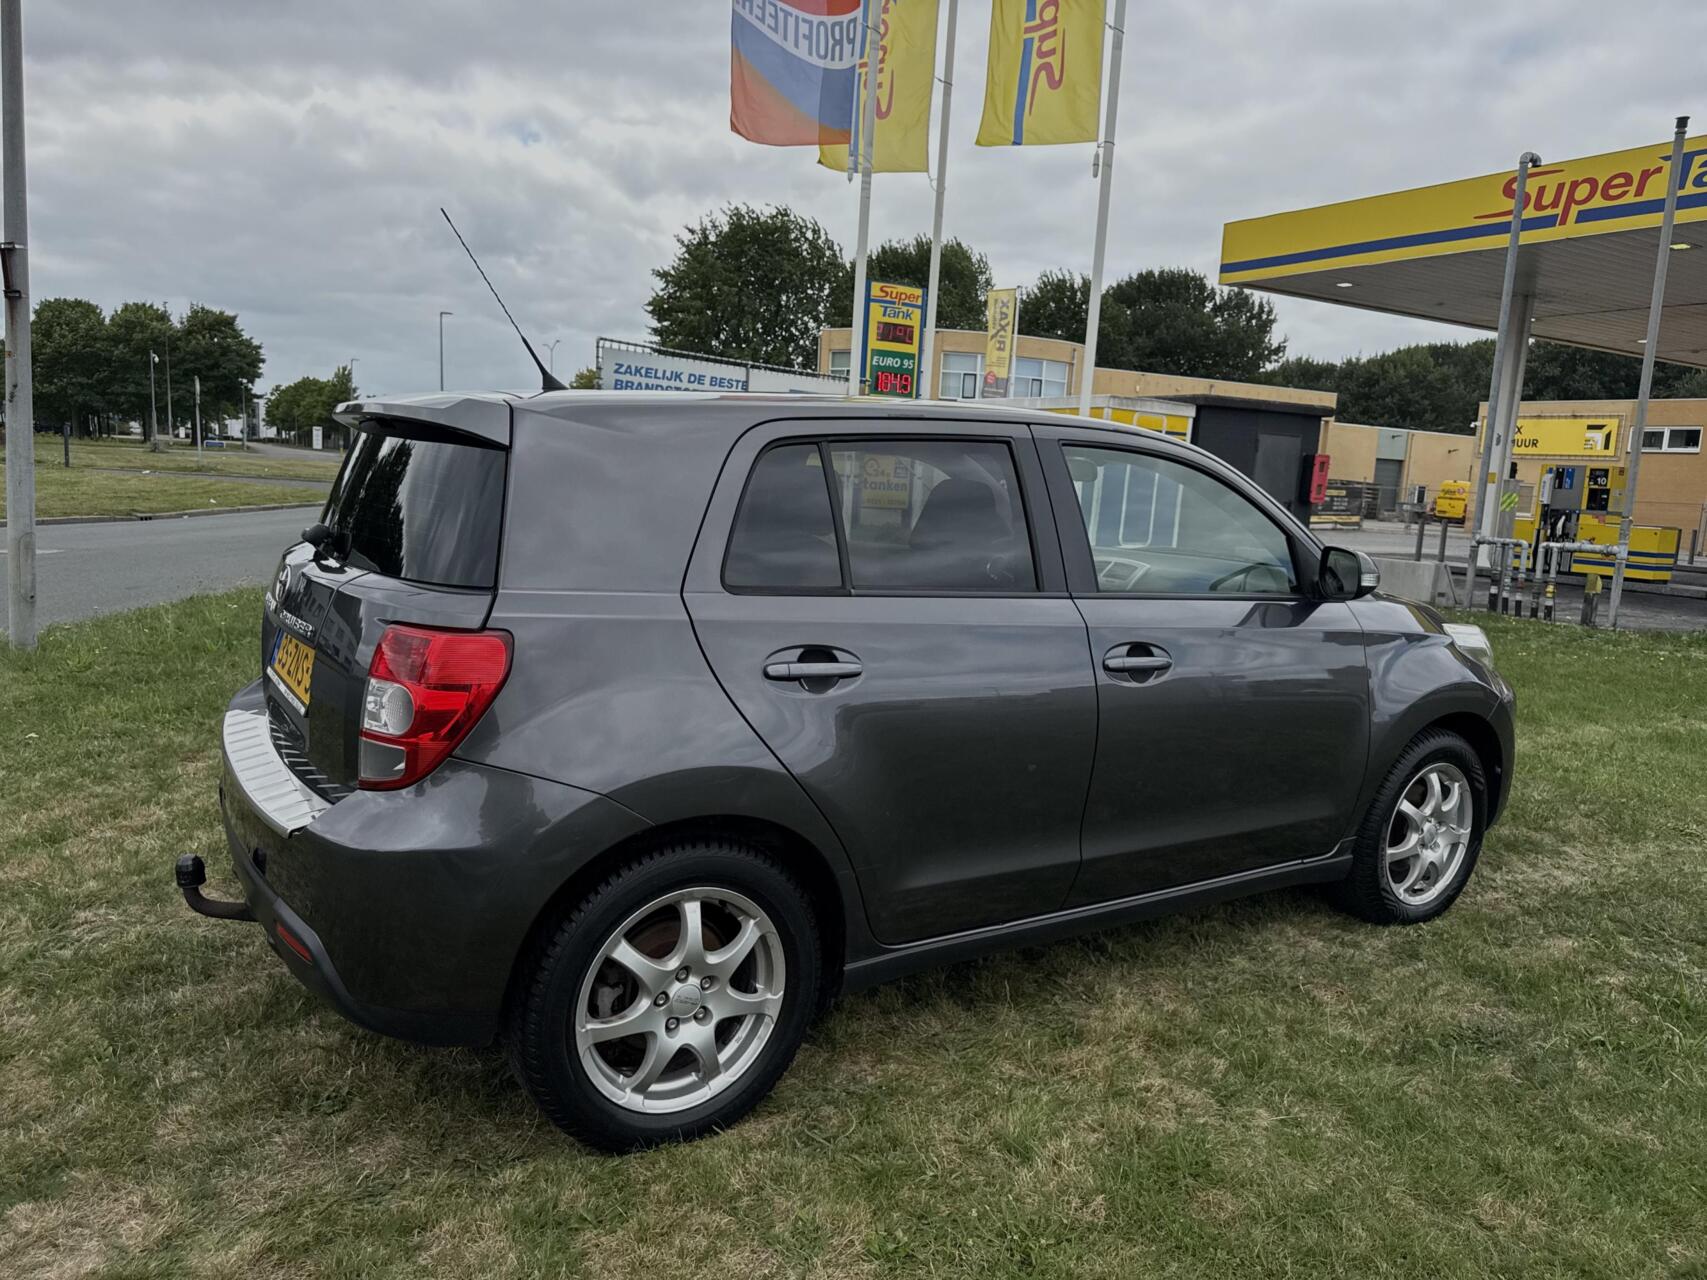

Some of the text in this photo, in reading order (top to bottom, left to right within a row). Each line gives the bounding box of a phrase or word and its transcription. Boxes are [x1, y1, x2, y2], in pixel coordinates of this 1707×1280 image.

[1473, 166, 1664, 226] Super
[872, 285, 921, 306] Super
[880, 305, 914, 320] Tank
[872, 356, 914, 369] EURO 95
[614, 363, 748, 391] ZAKELIJK DE BESTE
